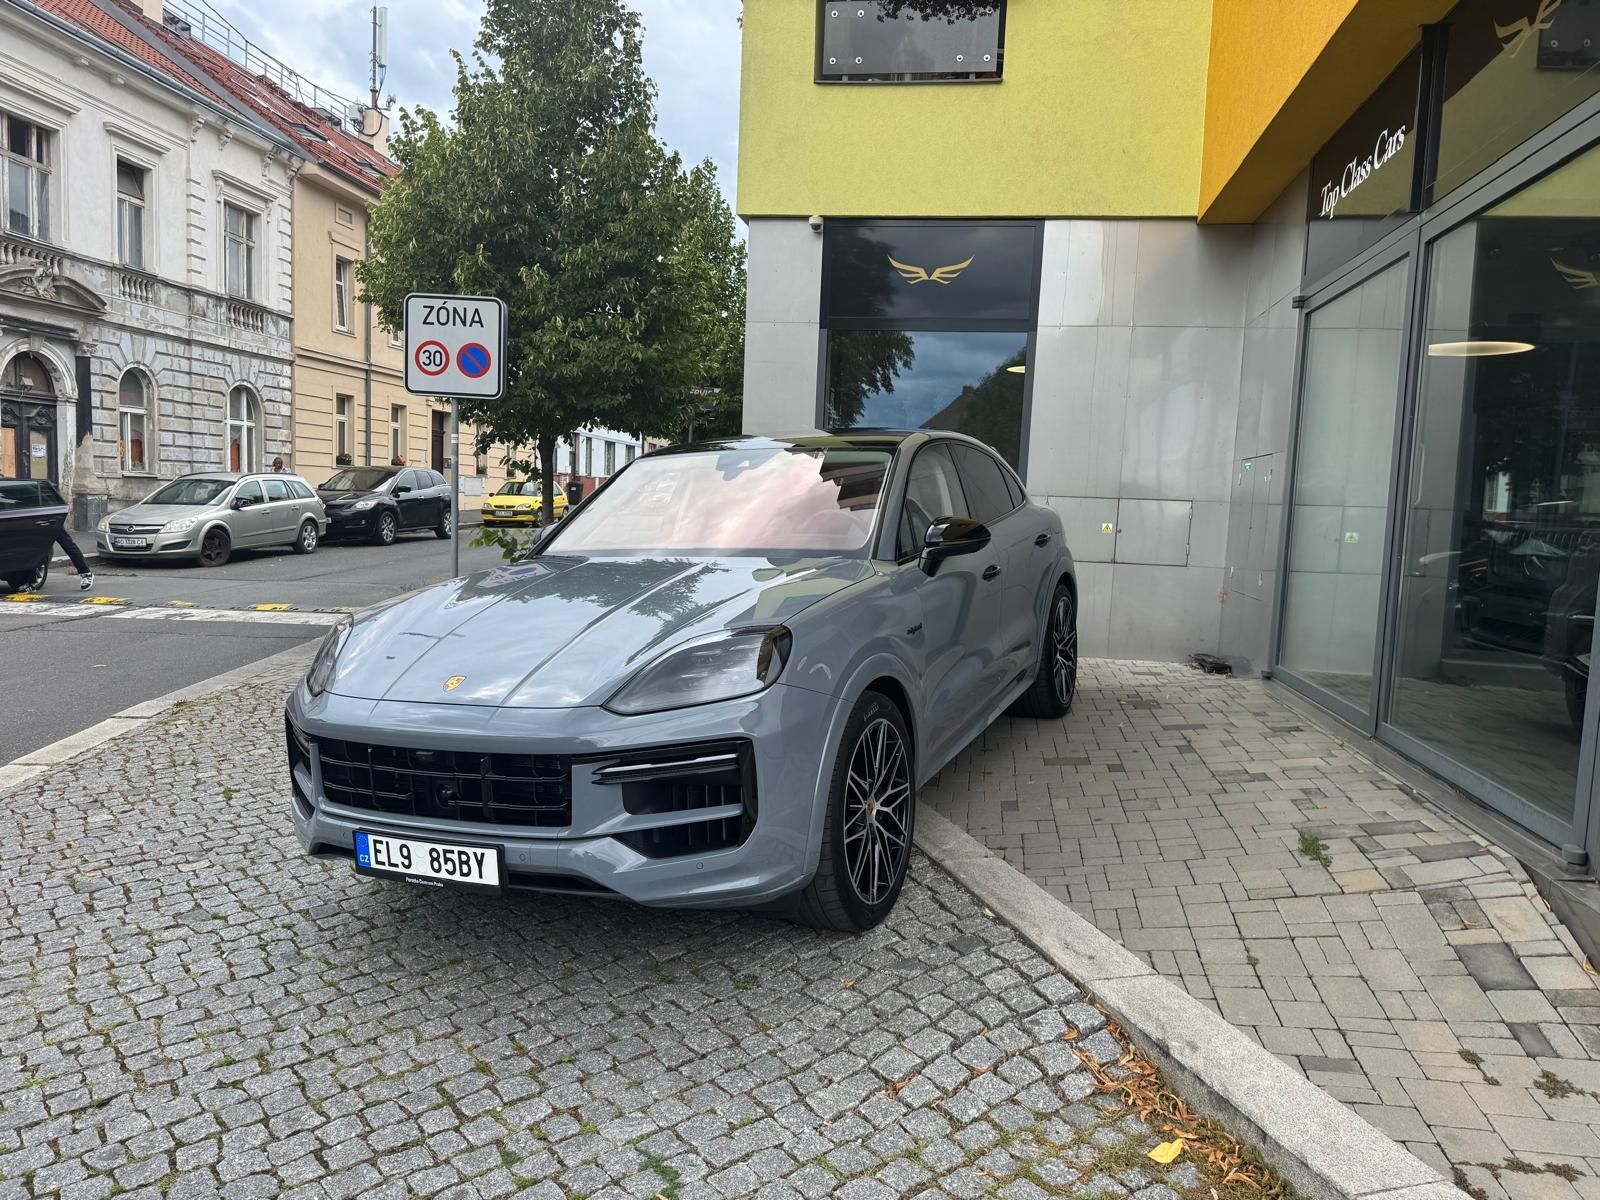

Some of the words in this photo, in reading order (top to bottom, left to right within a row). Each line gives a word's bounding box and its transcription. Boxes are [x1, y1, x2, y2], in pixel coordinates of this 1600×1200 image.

[1320, 180, 1340, 220] Top
[1340, 155, 1372, 198] Class
[1373, 125, 1406, 170] Cars
[422, 301, 484, 328] ZÓNA
[422, 349, 443, 367] 30
[359, 854, 370, 863] CZ
[372, 838, 412, 869] EL9
[428, 847, 485, 879] 85BY
